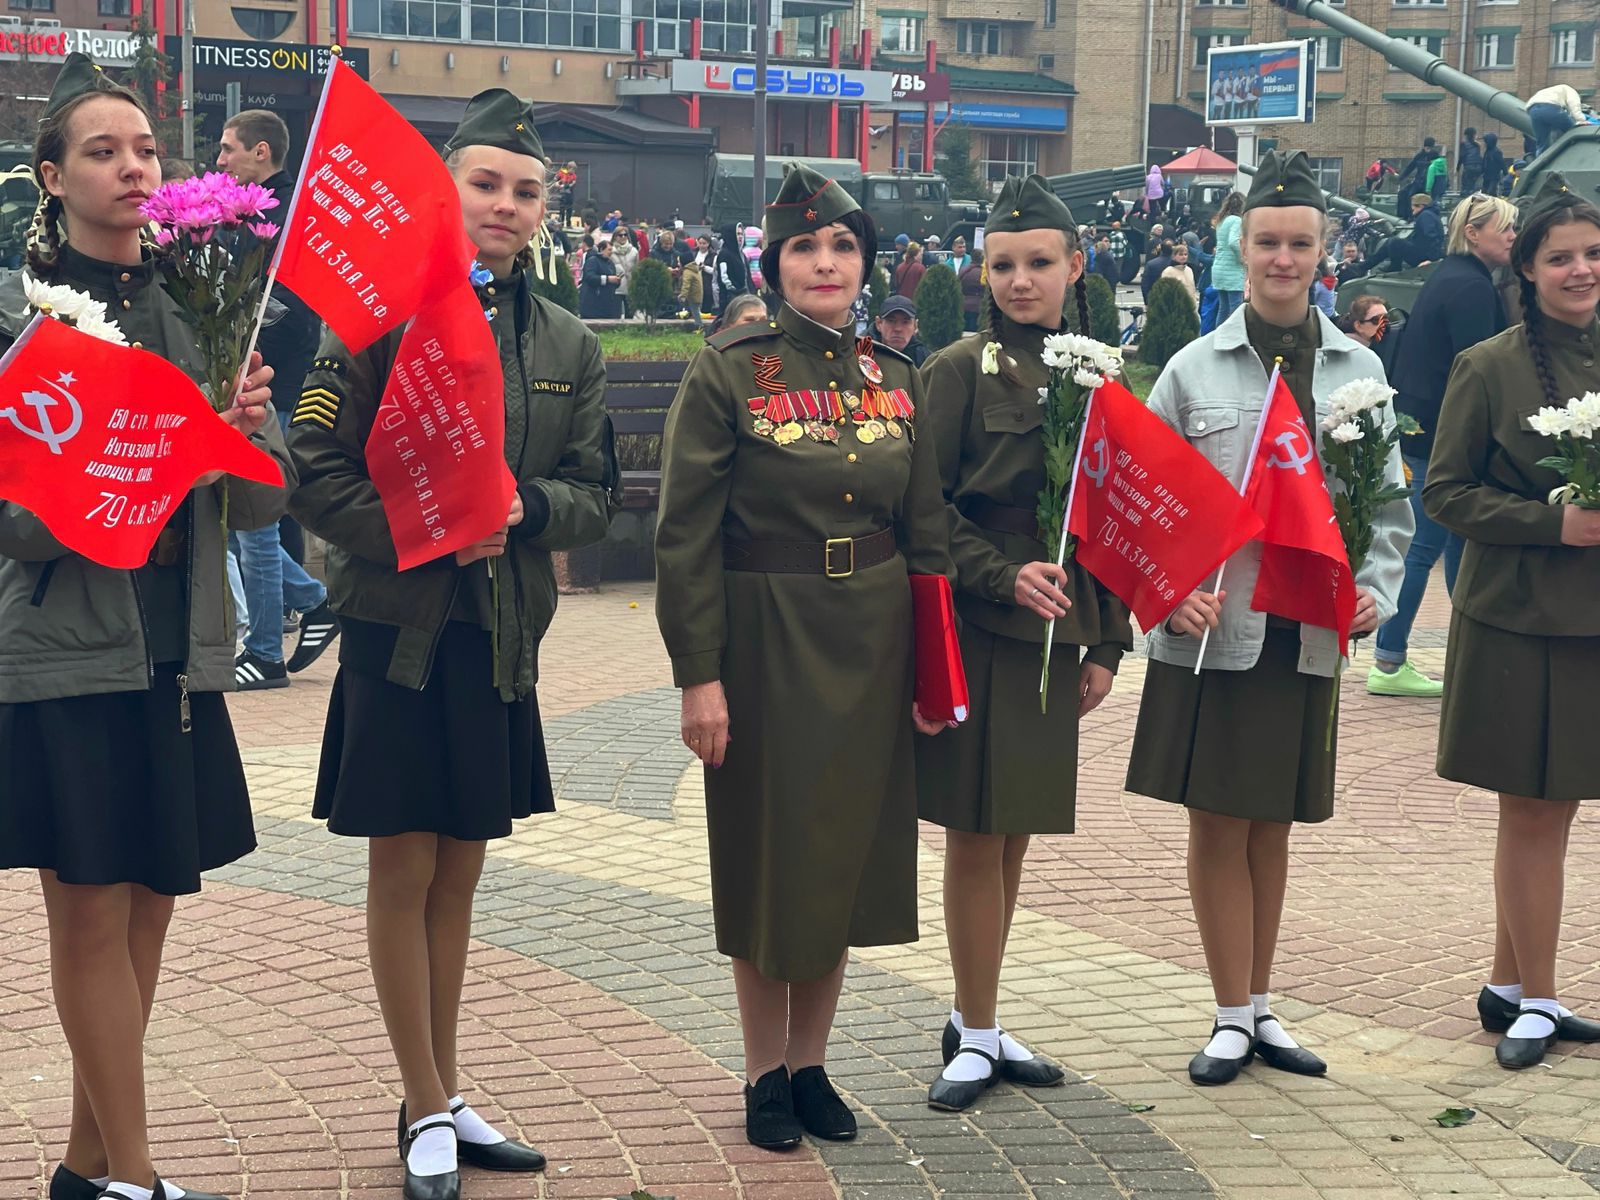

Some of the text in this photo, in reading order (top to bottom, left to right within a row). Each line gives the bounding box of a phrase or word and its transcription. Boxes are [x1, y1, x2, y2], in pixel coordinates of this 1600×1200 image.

[192, 45, 307, 70] ITNESSON
[247, 94, 276, 107] клуб
[328, 143, 352, 162] 150
[370, 180, 410, 224] ОРДЕНА
[422, 338, 444, 362] 150
[455, 400, 486, 449] ОРДЕНА
[550, 383, 571, 392] СТАР
[107, 408, 129, 430] 150
[379, 394, 406, 431] 79
[84, 460, 134, 483] ИДРИЦК.
[1115, 449, 1132, 468] 150
[1153, 484, 1189, 518] ОРДЕНА
[85, 491, 128, 528] 79
[1096, 514, 1119, 547] 79
